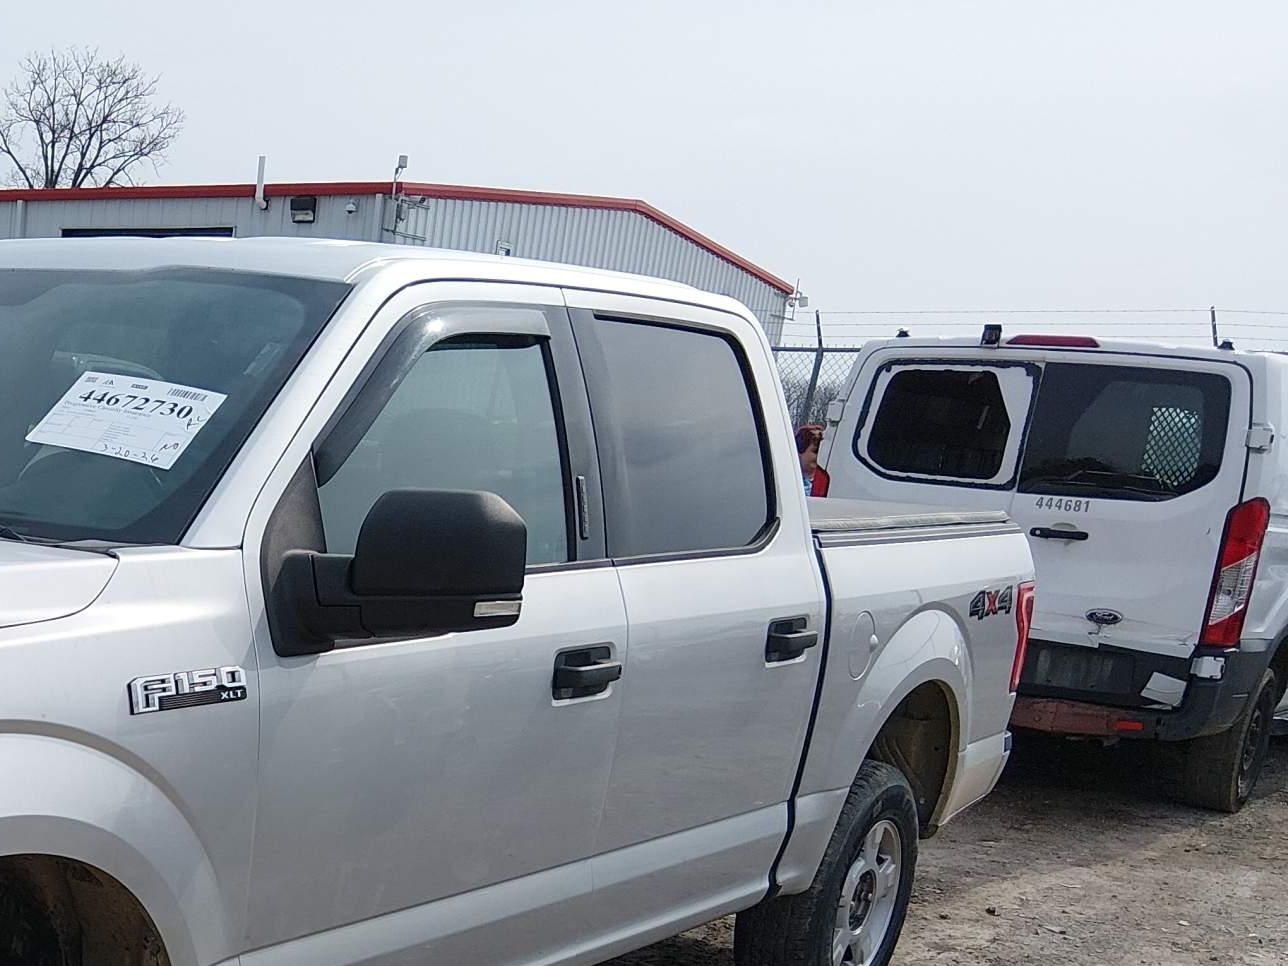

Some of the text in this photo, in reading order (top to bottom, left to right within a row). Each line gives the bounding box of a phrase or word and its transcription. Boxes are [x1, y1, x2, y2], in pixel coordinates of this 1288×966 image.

[79, 389, 193, 420] 44672730
[1035, 496, 1091, 513] 444681
[220, 689, 243, 700] XLT
